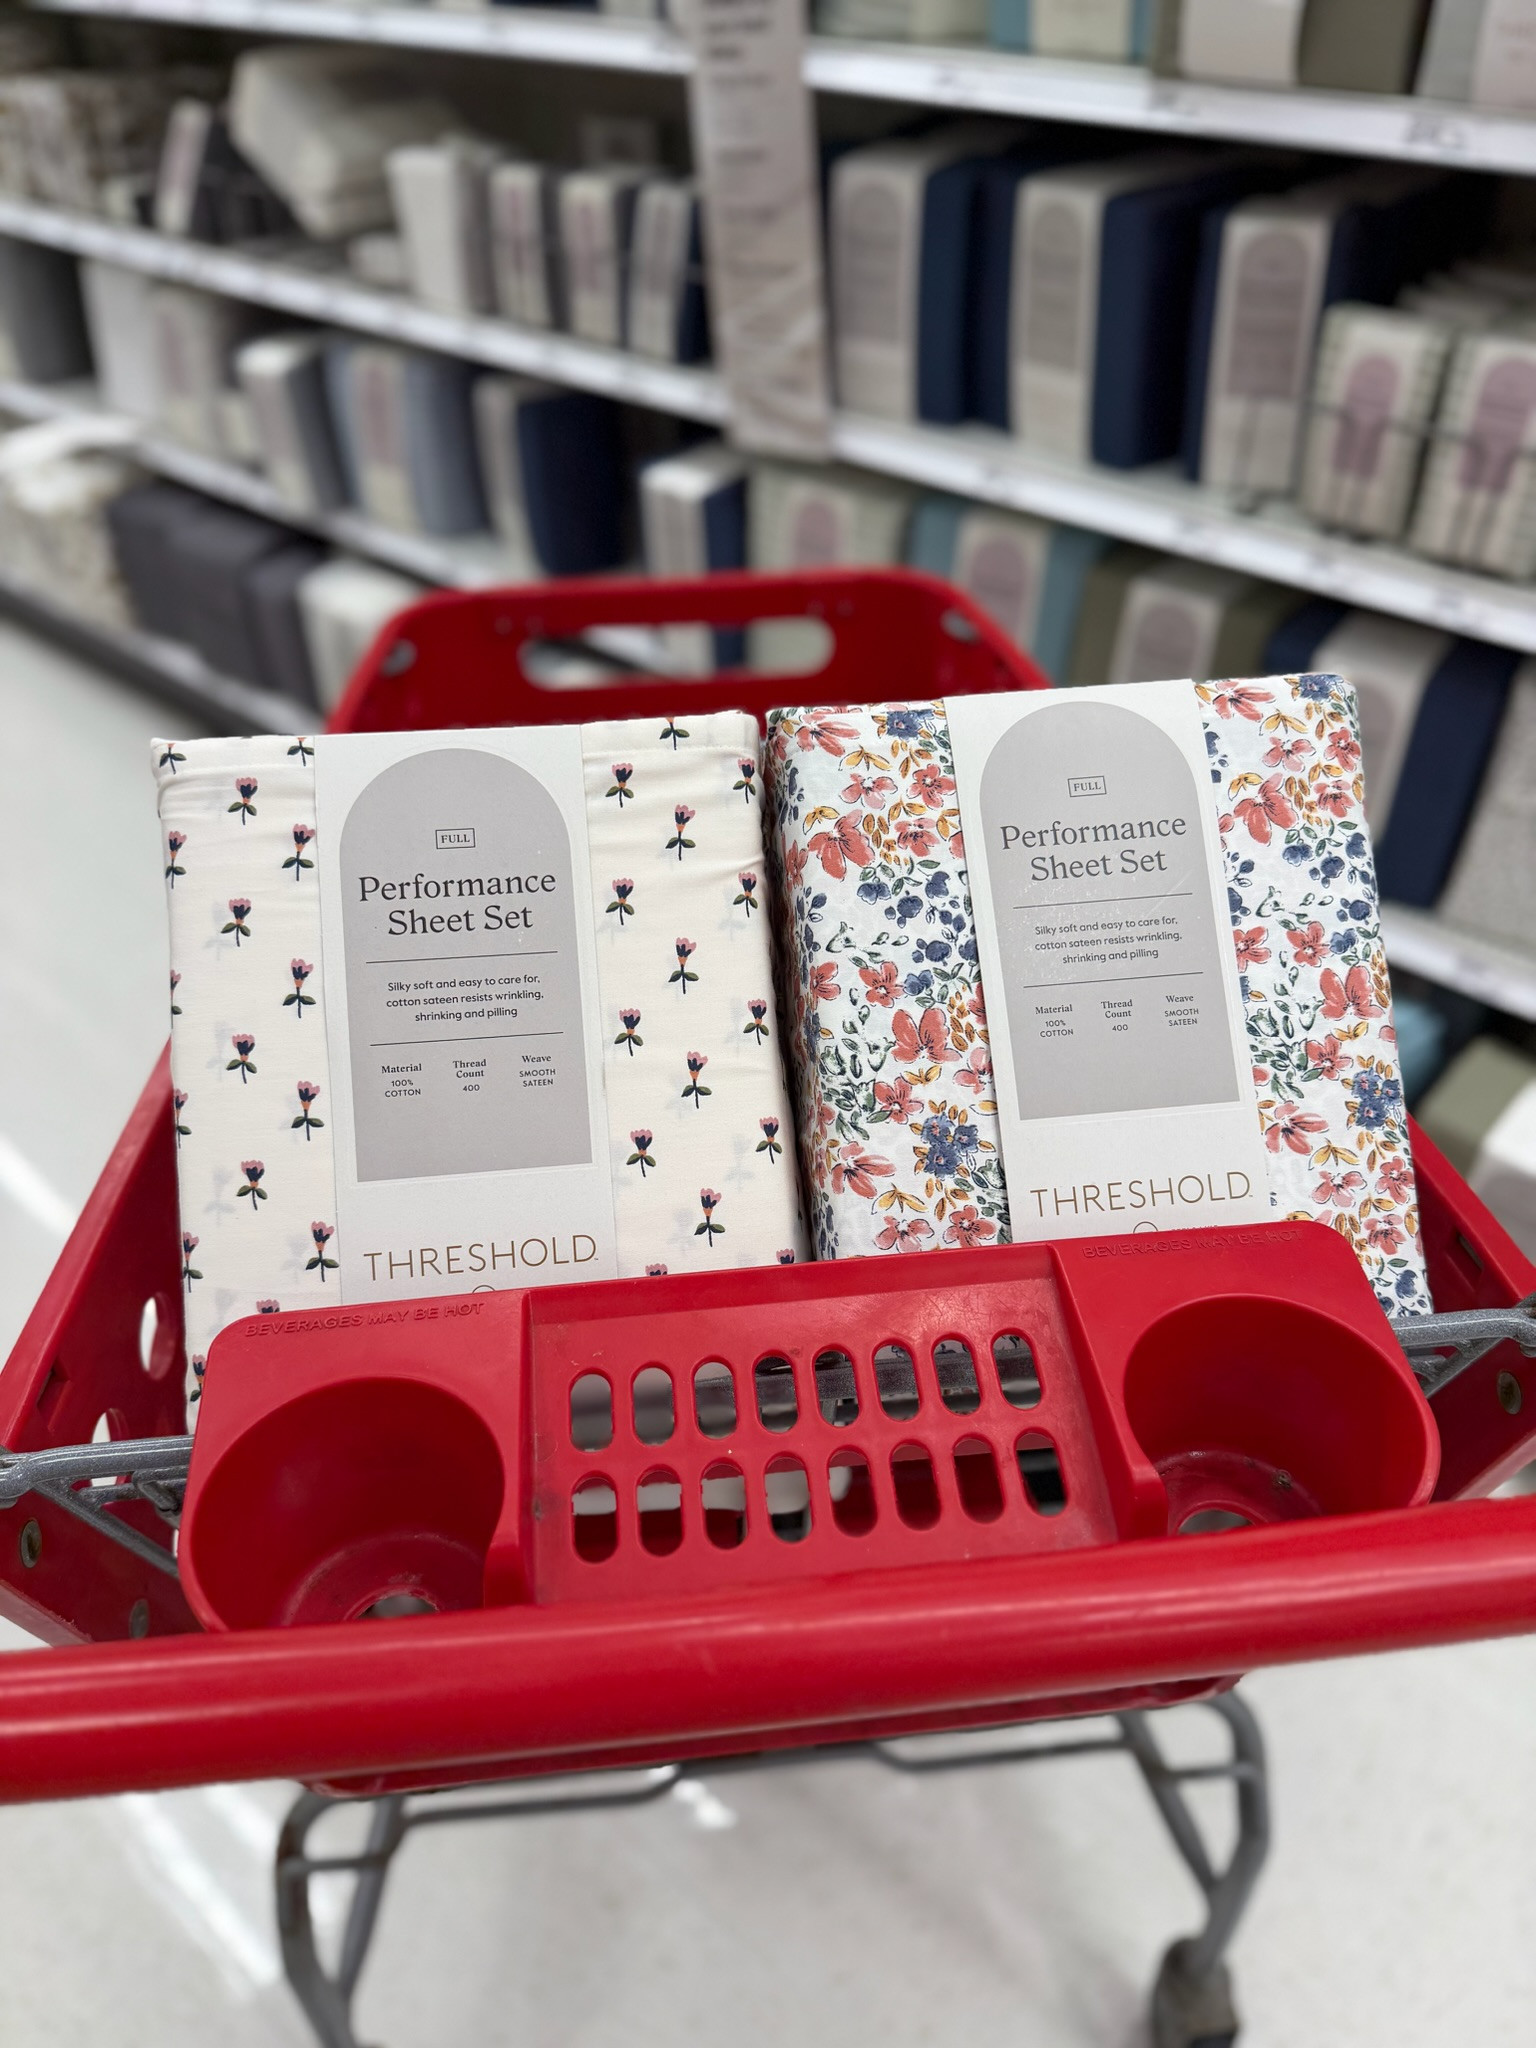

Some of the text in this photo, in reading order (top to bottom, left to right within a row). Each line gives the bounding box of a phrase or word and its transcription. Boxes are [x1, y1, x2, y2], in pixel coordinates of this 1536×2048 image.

[1074, 782, 1101, 792] FULL
[1000, 817, 1187, 850] Performance
[441, 834, 470, 844] FULL
[1031, 849, 1168, 881] Sheet Set
[359, 873, 556, 902] Performance
[388, 905, 534, 935] Sheet Set
[1035, 926, 1057, 936] Silky
[1059, 924, 1078, 934] soft
[1080, 922, 1099, 932] and
[1100, 921, 1123, 931] easy
[1125, 920, 1136, 928] to
[1138, 918, 1160, 926] care
[1035, 941, 1067, 950] cotton
[1068, 938, 1102, 948] sateen
[1104, 935, 1135, 945] resists
[1062, 948, 1159, 964] shrinking and pilling
[388, 982, 411, 993] Silky
[414, 980, 434, 990] soft
[436, 979, 456, 988] and
[458, 978, 482, 988] easy
[484, 978, 496, 986] to
[498, 976, 522, 985] care
[386, 998, 421, 1008] cotton
[423, 996, 459, 1006] sateen
[460, 993, 493, 1003] resists
[1100, 999, 1133, 1010] Thread
[1165, 995, 1194, 1004] Weave
[1035, 1004, 1073, 1014] Material
[1164, 1008, 1200, 1018] SMOOTH
[415, 1007, 518, 1022] shrinking and pilling
[1104, 1010, 1132, 1019] Count
[1045, 1019, 1066, 1028] 100%
[1168, 1018, 1198, 1027] SATEEN
[1040, 1028, 1074, 1038] COTTON
[1112, 1024, 1129, 1032] 400
[452, 1059, 487, 1069] Thread
[521, 1055, 552, 1064] Weave
[381, 1064, 422, 1074] Material
[519, 1068, 556, 1078] SMOOTH
[456, 1070, 485, 1079] Count
[390, 1079, 414, 1088] 100%
[462, 1084, 480, 1092] 400
[522, 1079, 554, 1088] SATEEN
[384, 1089, 422, 1098] COTTON
[1030, 1171, 1251, 1217] THRESHOLD
[1082, 1230, 1302, 1259] BEVERAGES MAY BE HOT
[363, 1234, 597, 1281] THRESHOLD
[244, 1302, 485, 1337] BEVERAGES MAY BE HOT
